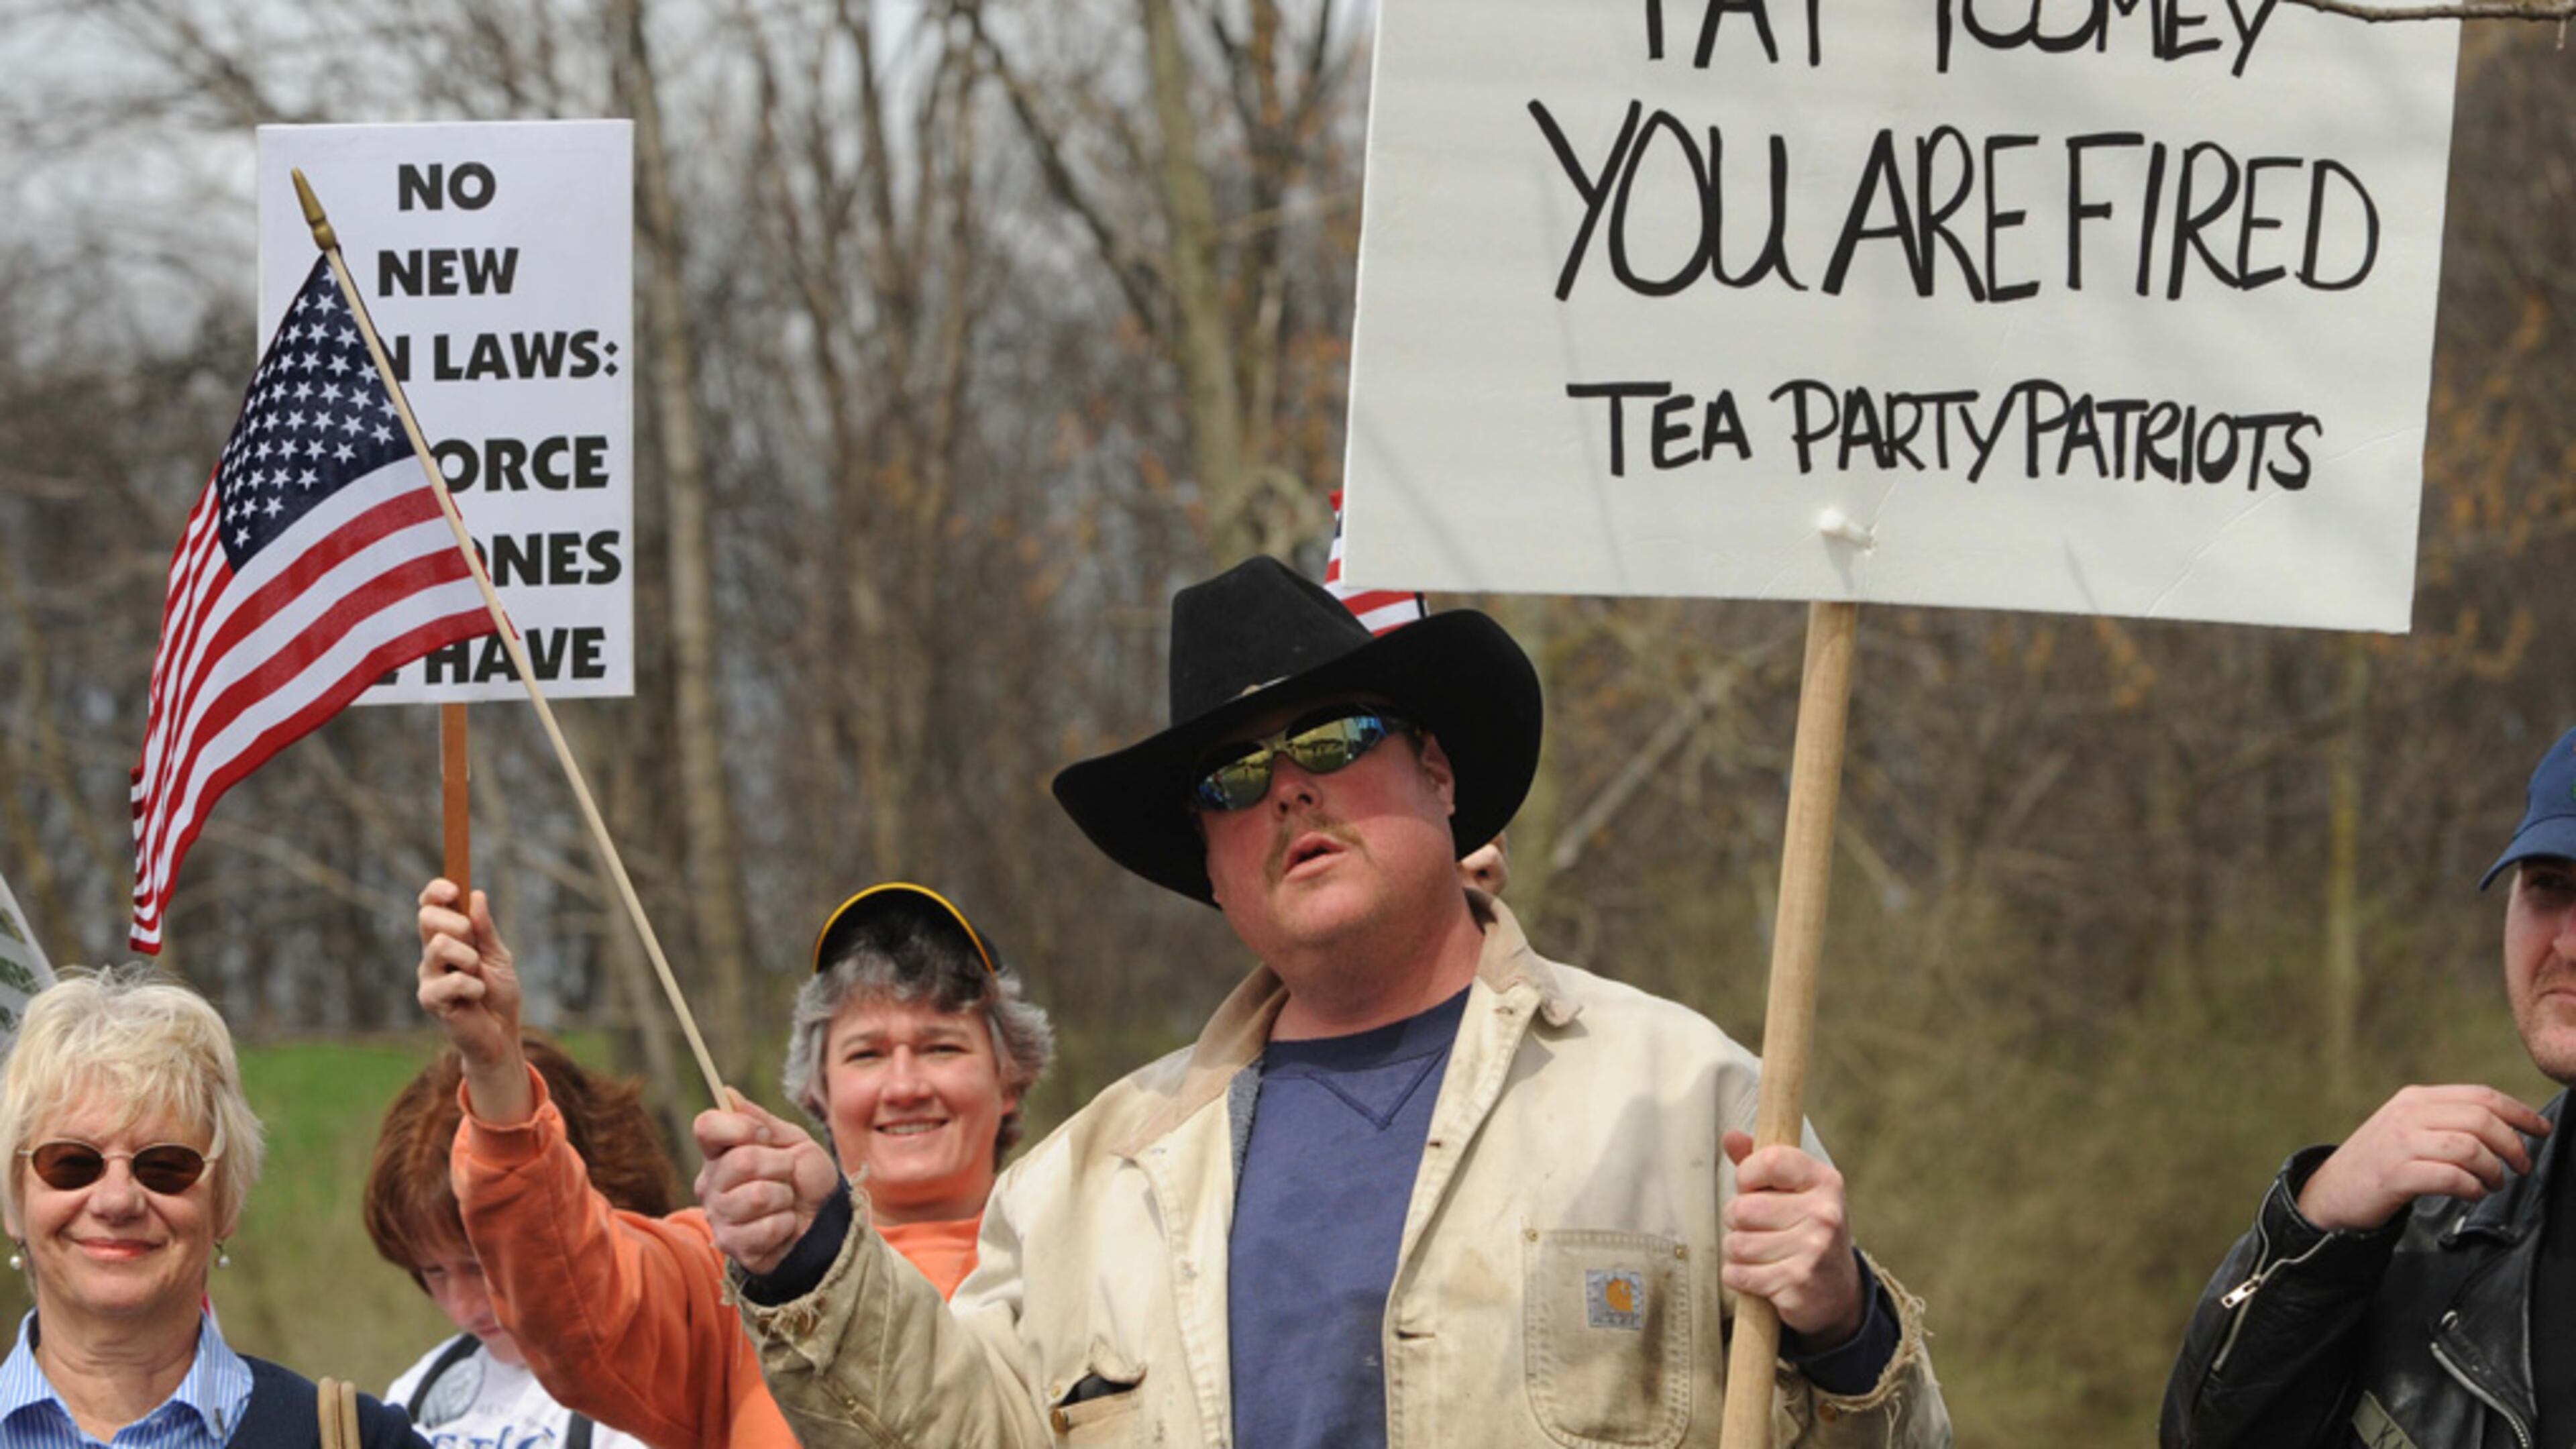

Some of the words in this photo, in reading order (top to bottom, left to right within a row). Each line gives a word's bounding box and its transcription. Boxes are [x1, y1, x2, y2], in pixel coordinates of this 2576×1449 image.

[398, 162, 496, 211] NO
[1527, 99, 1809, 303] YOU
[1821, 124, 2041, 304] ARE
[2065, 131, 2380, 302] FIRED
[378, 247, 519, 298] NEW
[433, 329, 619, 382] LAWS:
[1565, 381, 1752, 478] TEA
[1768, 378, 2014, 484] PARTY
[2011, 378, 2323, 492] PATRIOTS
[428, 435, 610, 495] ORCE
[472, 529, 622, 588] NES
[424, 626, 607, 685] HAVE
